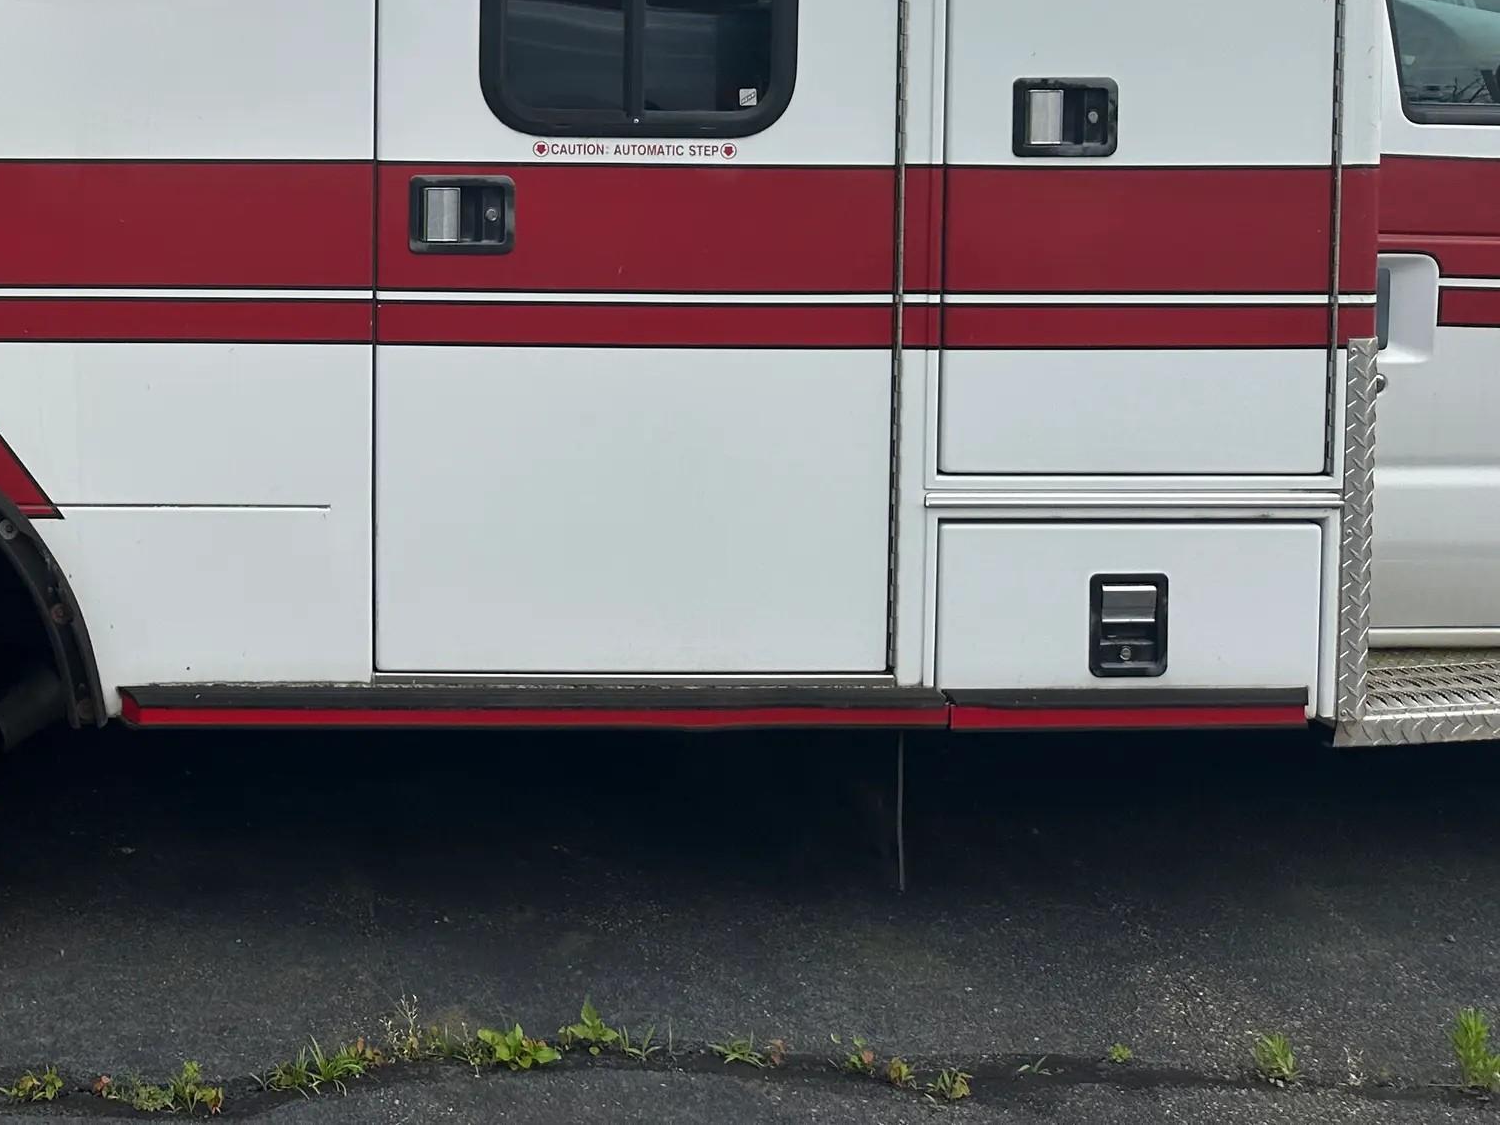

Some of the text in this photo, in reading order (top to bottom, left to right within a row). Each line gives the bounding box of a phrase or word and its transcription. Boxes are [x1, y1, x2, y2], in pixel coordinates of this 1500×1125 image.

[551, 143, 719, 157] CAUTION: AUTOMATIC STEP
